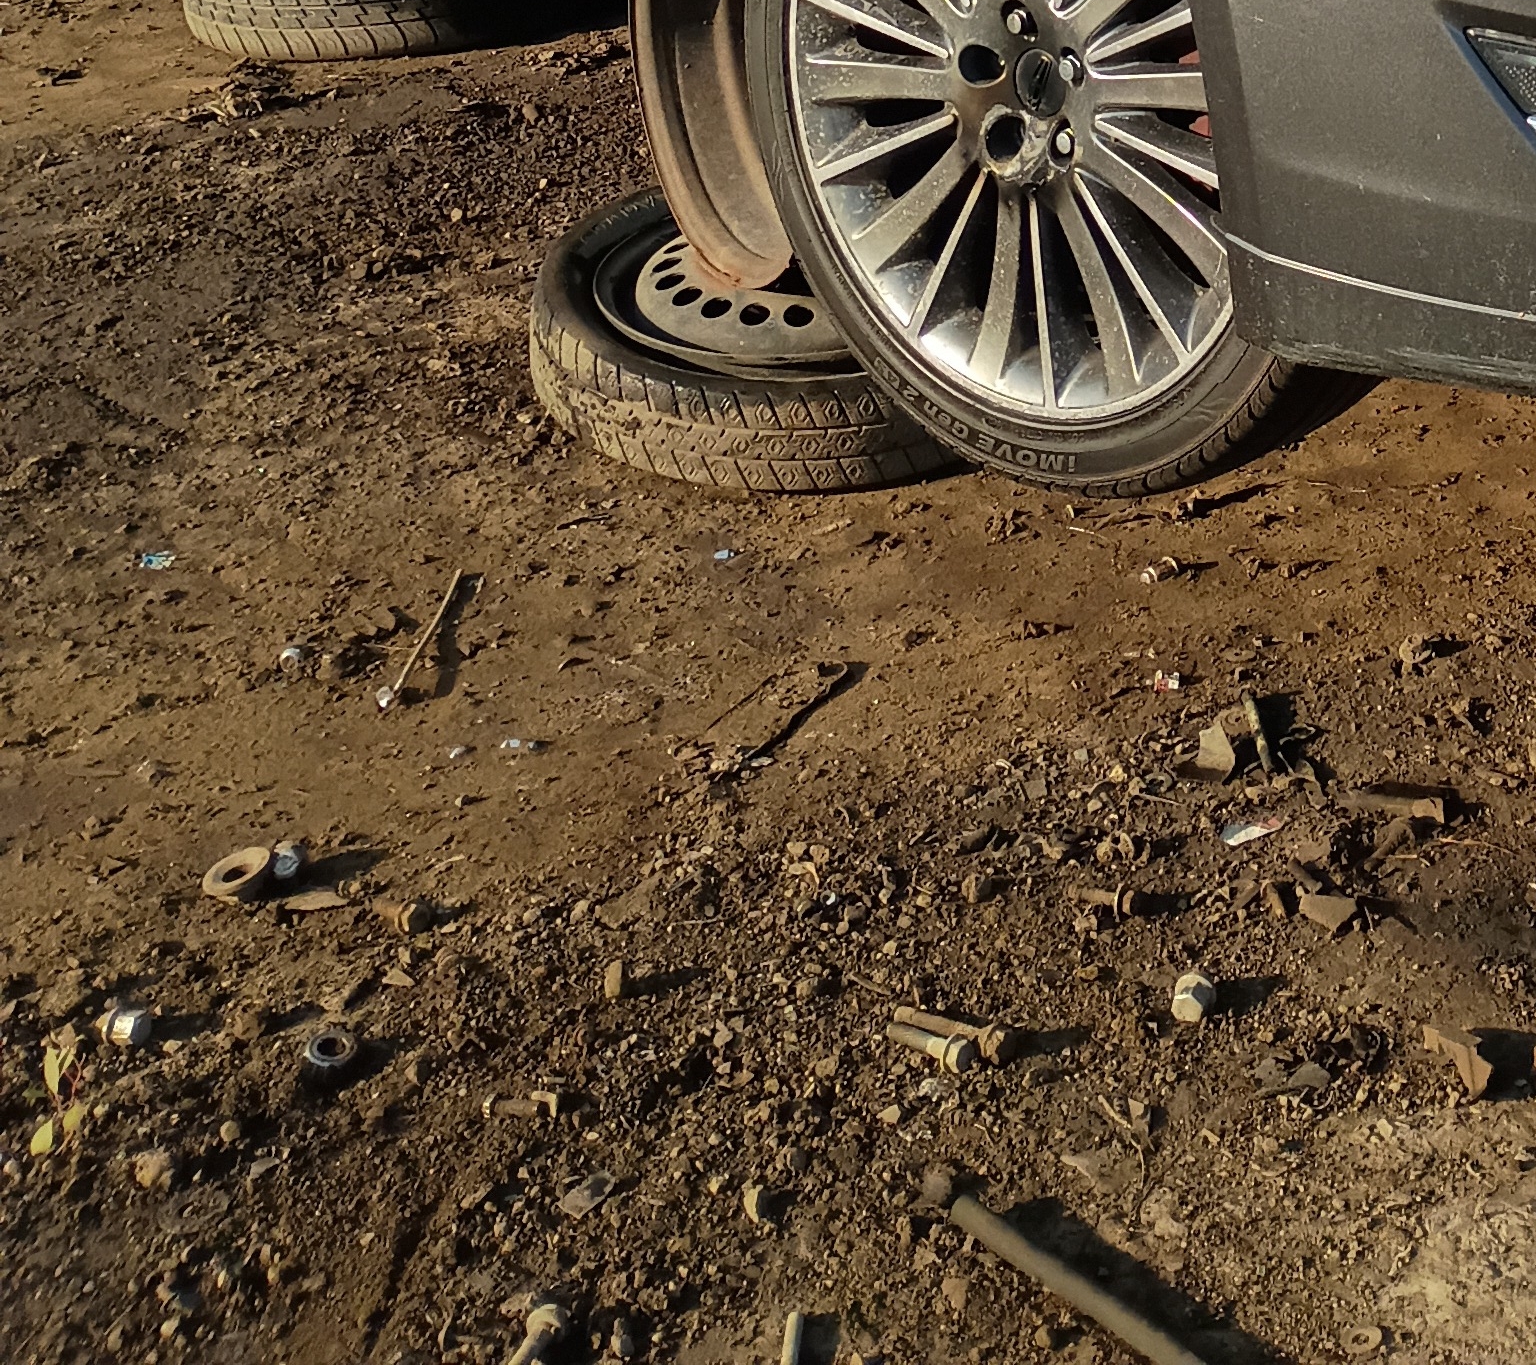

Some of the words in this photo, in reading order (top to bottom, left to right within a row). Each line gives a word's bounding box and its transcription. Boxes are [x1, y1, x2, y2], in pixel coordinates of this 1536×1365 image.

[902, 385, 921, 402] 2
[924, 400, 970, 440] Gen
[975, 433, 1077, 473] iMOVE
